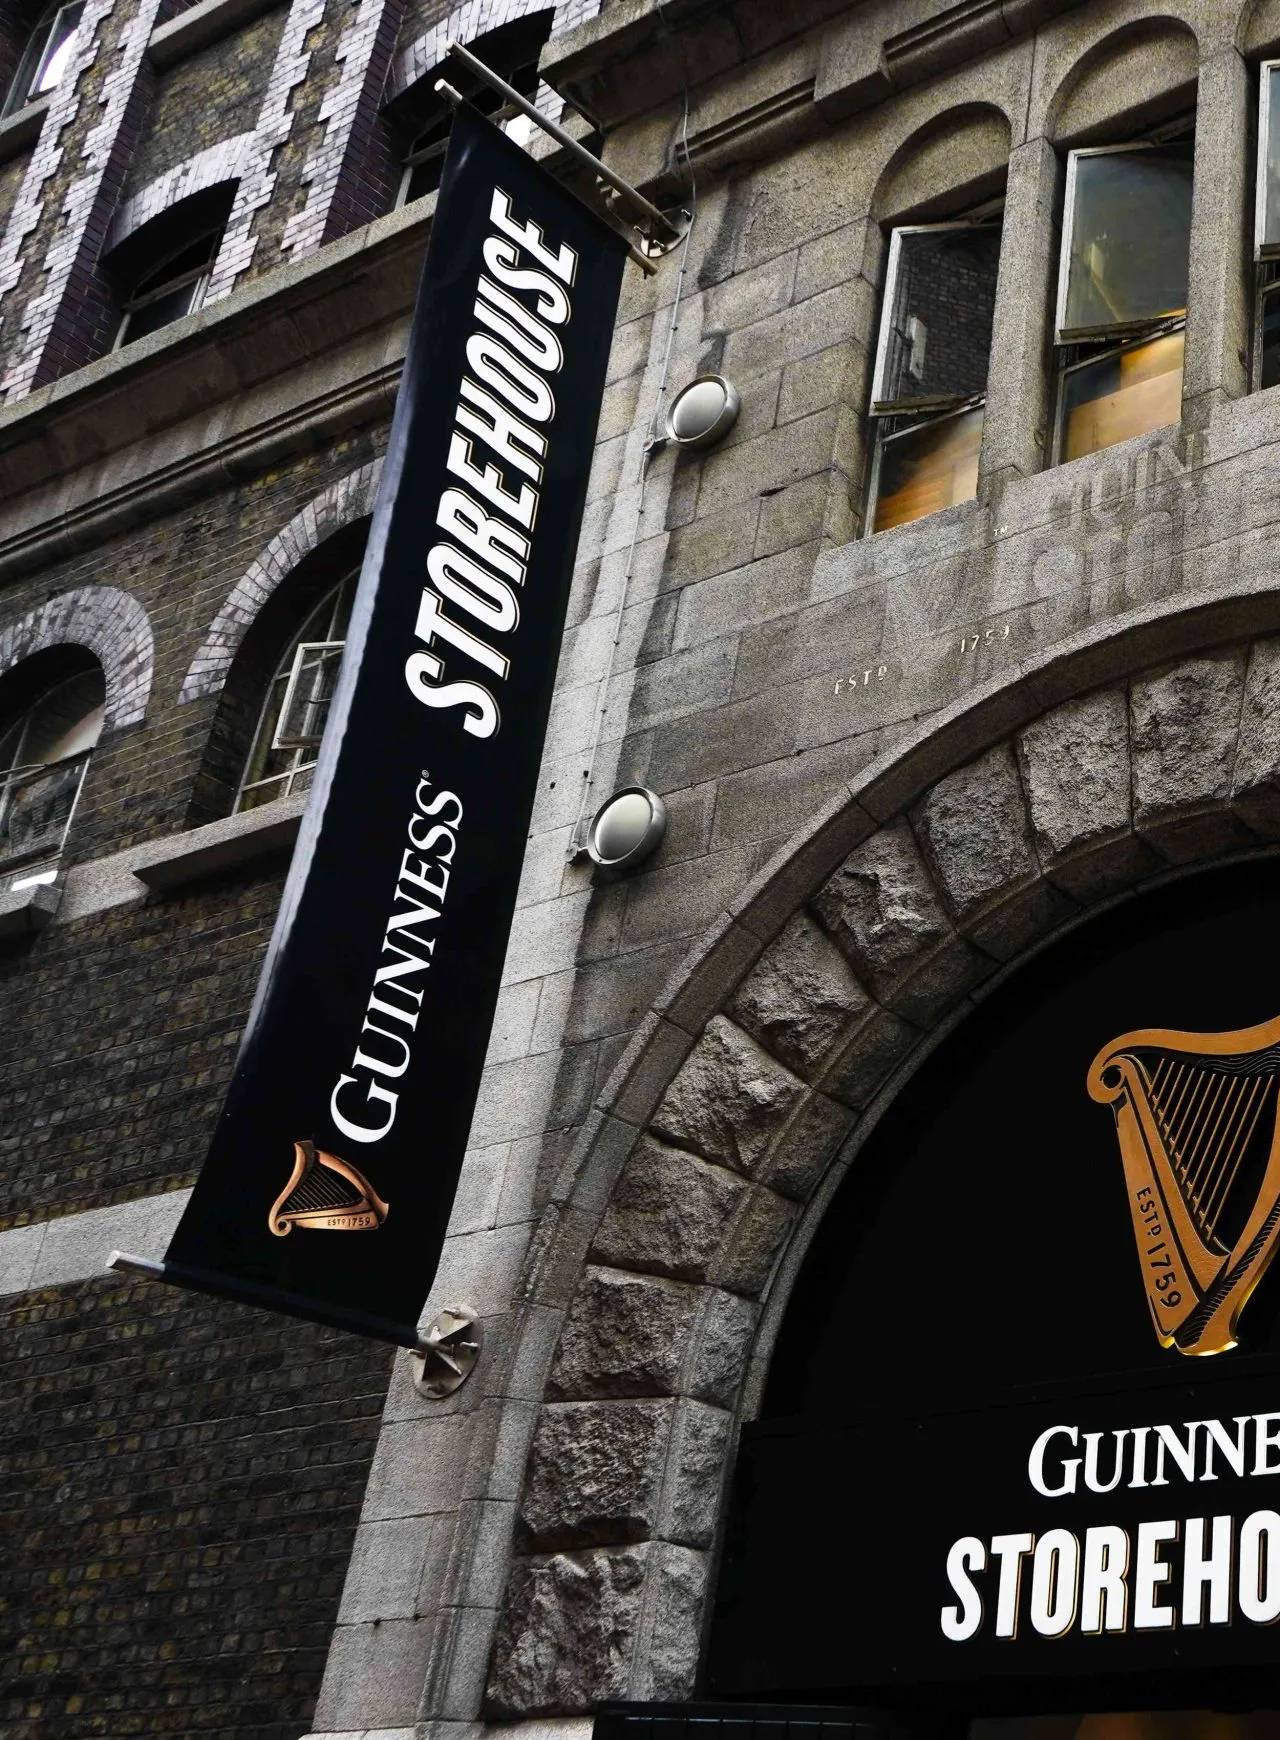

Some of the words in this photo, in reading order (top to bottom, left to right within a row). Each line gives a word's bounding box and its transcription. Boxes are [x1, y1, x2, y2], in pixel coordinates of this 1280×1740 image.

[404, 185, 579, 740] STOREHOUSE
[347, 1216, 371, 1228] 1759
[1147, 1241, 1183, 1308] 1759
